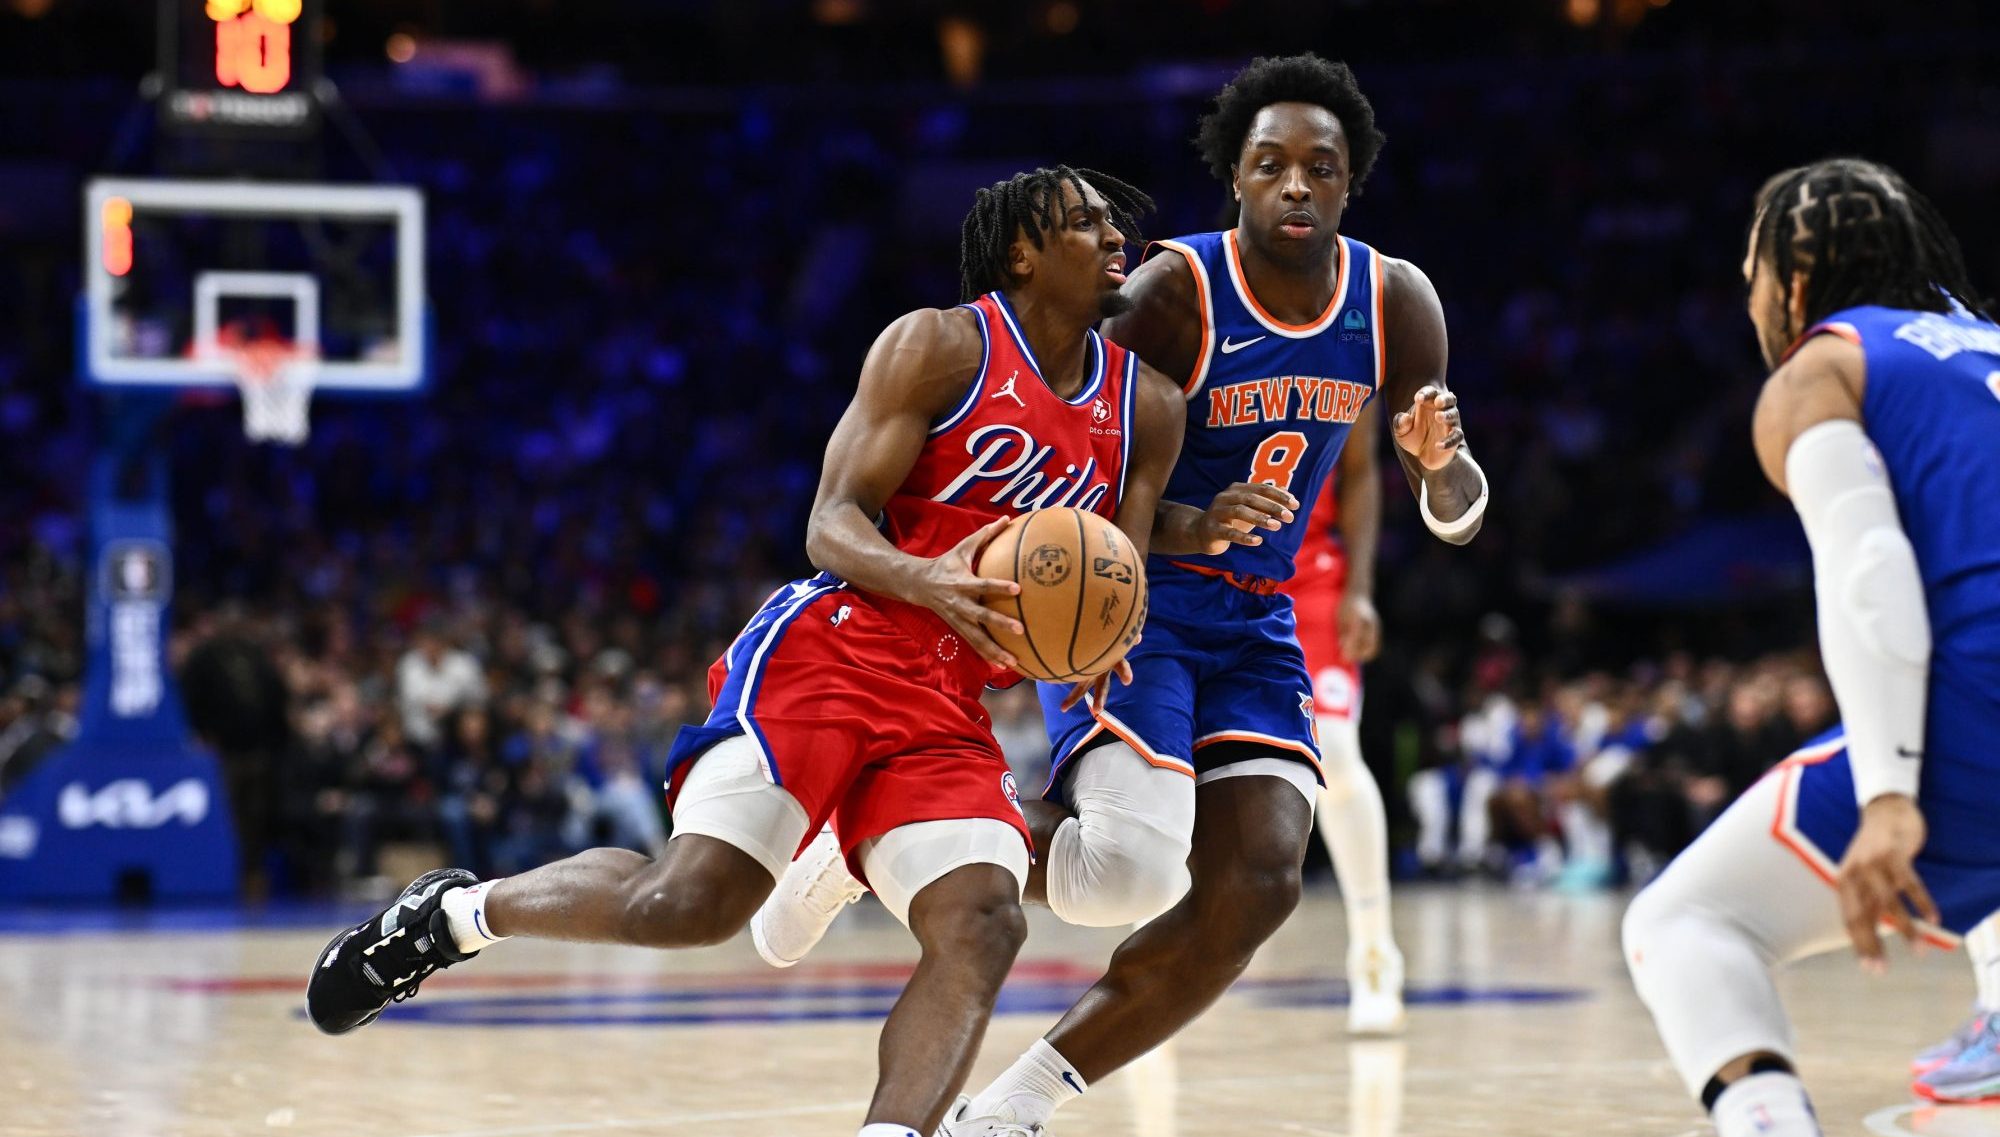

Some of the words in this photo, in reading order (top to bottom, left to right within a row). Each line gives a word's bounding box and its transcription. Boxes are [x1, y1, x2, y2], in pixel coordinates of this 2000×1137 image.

[1206, 375, 1294, 428] NEW
[1294, 375, 1373, 424] YORK
[1247, 431, 1309, 491] 8
